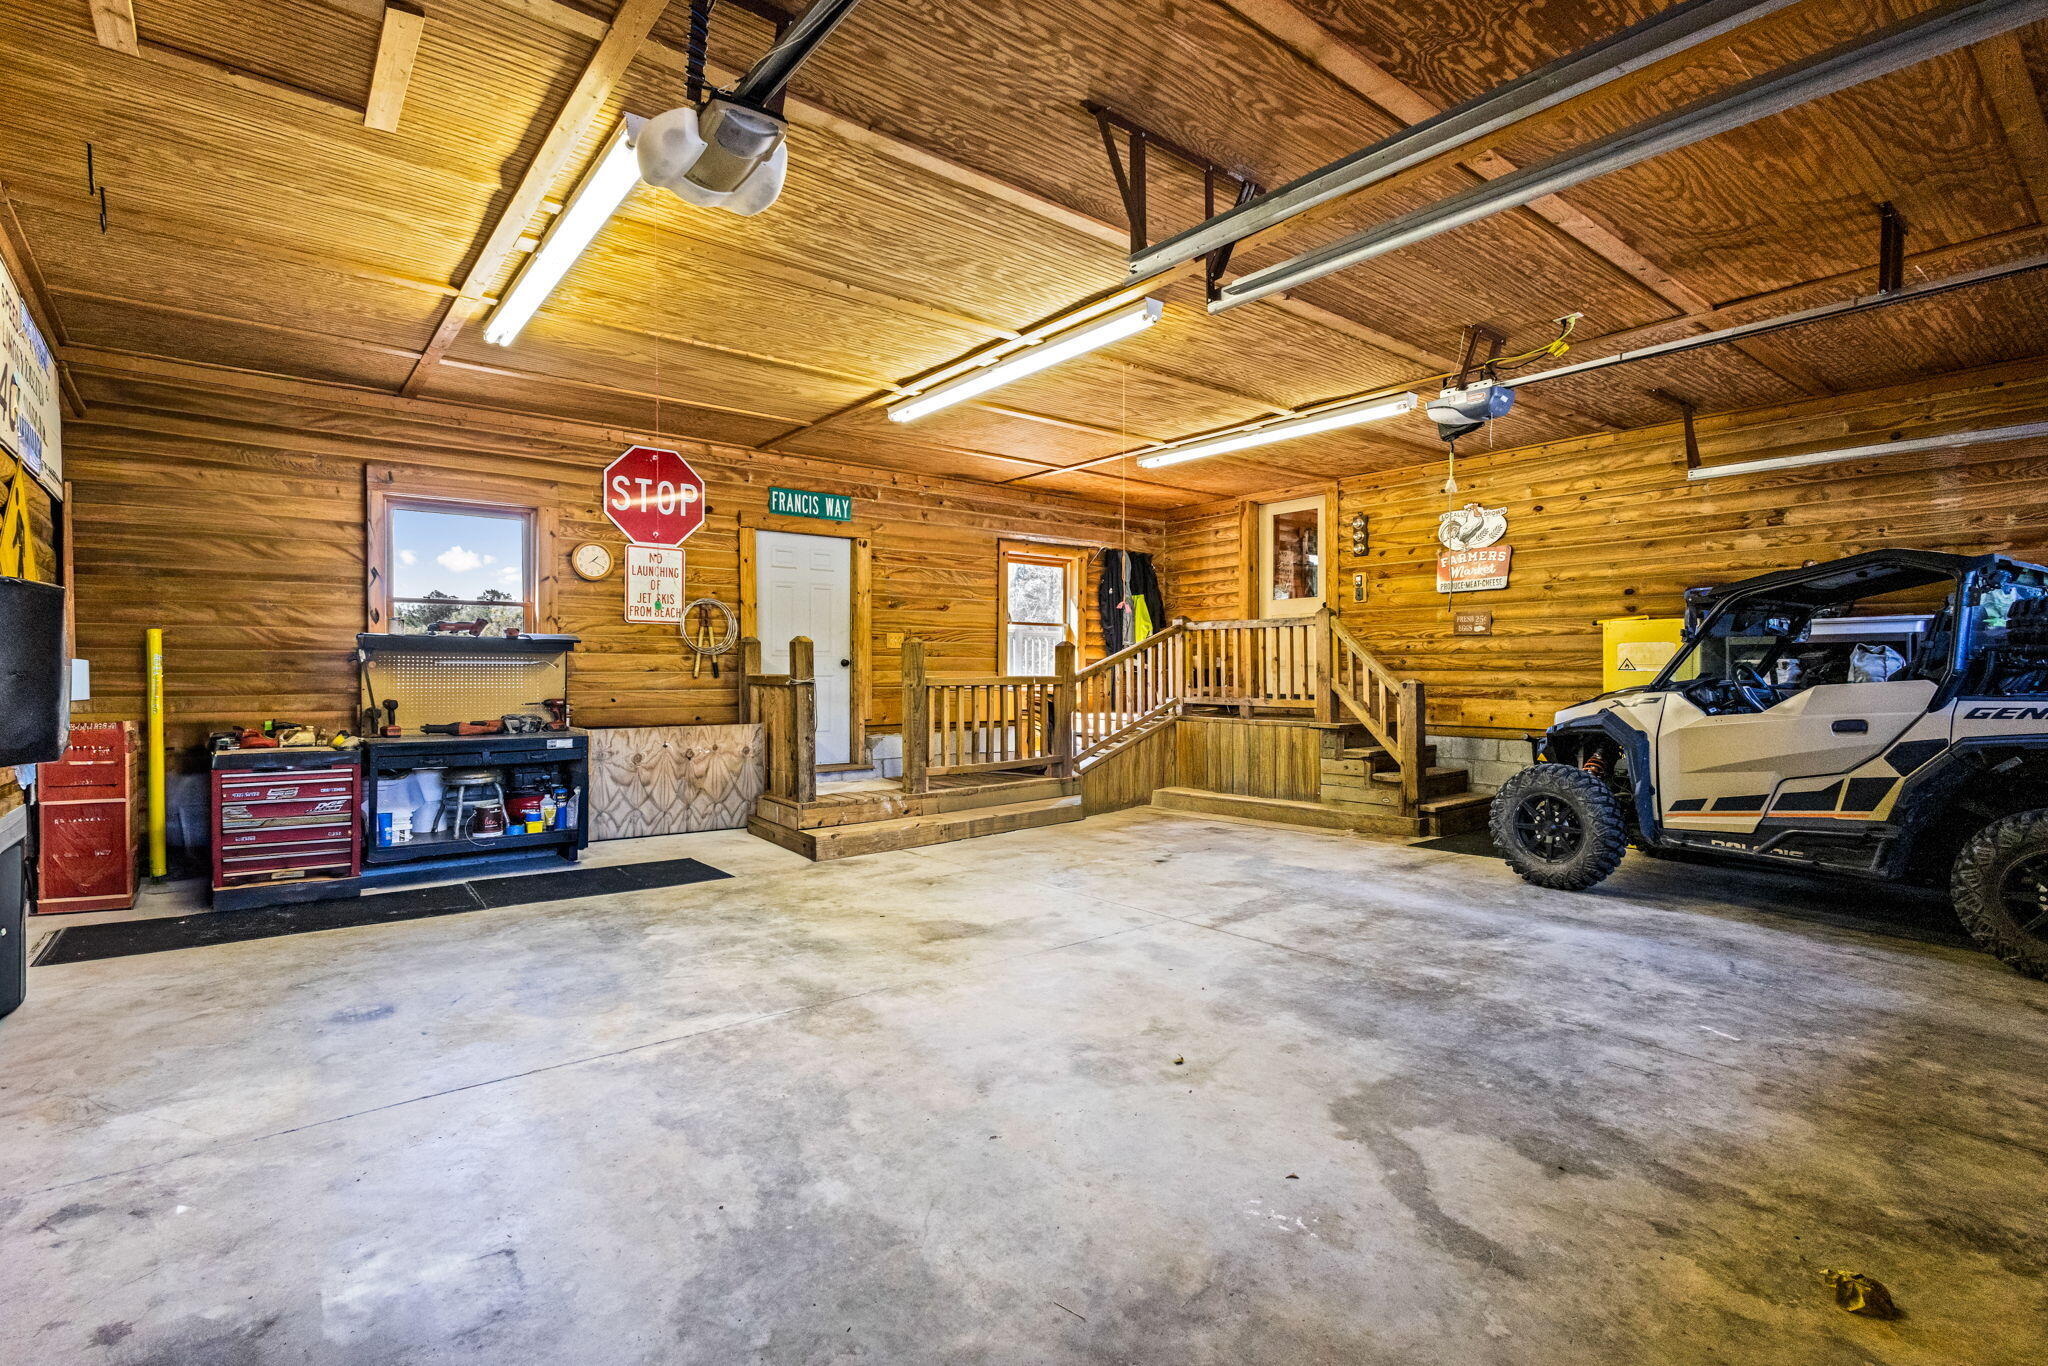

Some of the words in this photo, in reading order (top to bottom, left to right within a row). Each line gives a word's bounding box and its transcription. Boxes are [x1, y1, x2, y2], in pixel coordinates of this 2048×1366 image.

[611, 475, 698, 517] STOP
[772, 491, 819, 515] FRANCIS
[825, 497, 849, 519] WAY
[1441, 512, 1467, 522] LOCALLY
[1484, 508, 1506, 517] GROWN
[649, 552, 663, 564] NO
[1440, 551, 1507, 568] FARMERS
[631, 565, 679, 579] LAUNCHING
[1450, 562, 1496, 579] Market
[650, 579, 661, 590] OF
[637, 592, 652, 604] JET
[629, 605, 652, 617] FROM
[654, 607, 681, 618] BEACH
